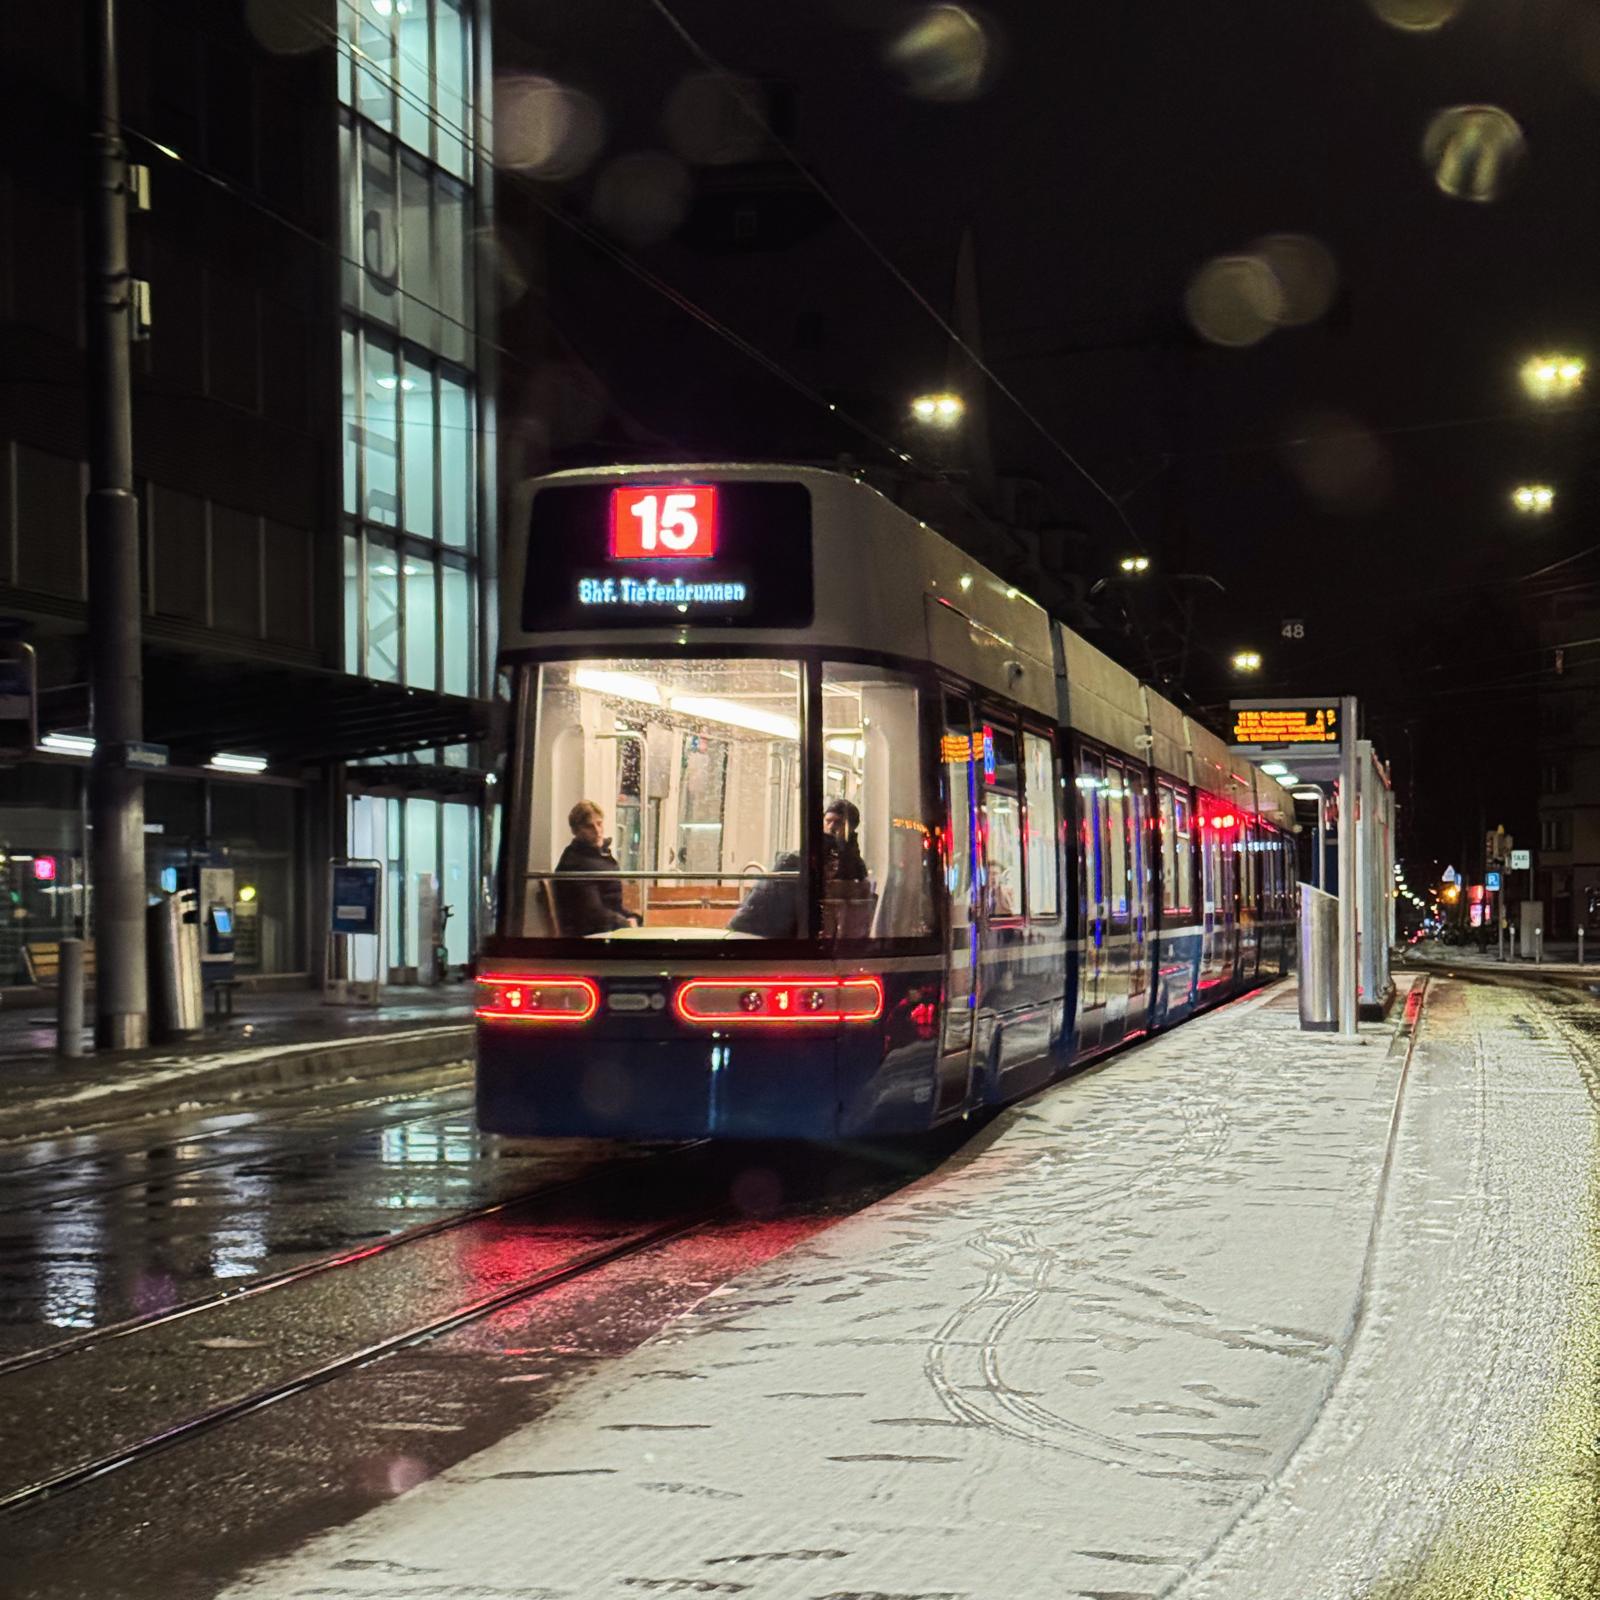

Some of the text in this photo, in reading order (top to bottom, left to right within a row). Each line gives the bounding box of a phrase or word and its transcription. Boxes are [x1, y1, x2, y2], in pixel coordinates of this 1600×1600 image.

[630, 494, 698, 550] 15
[579, 577, 746, 603] Bhf. Tiefenbrunnen
[1281, 624, 1304, 638] 48
